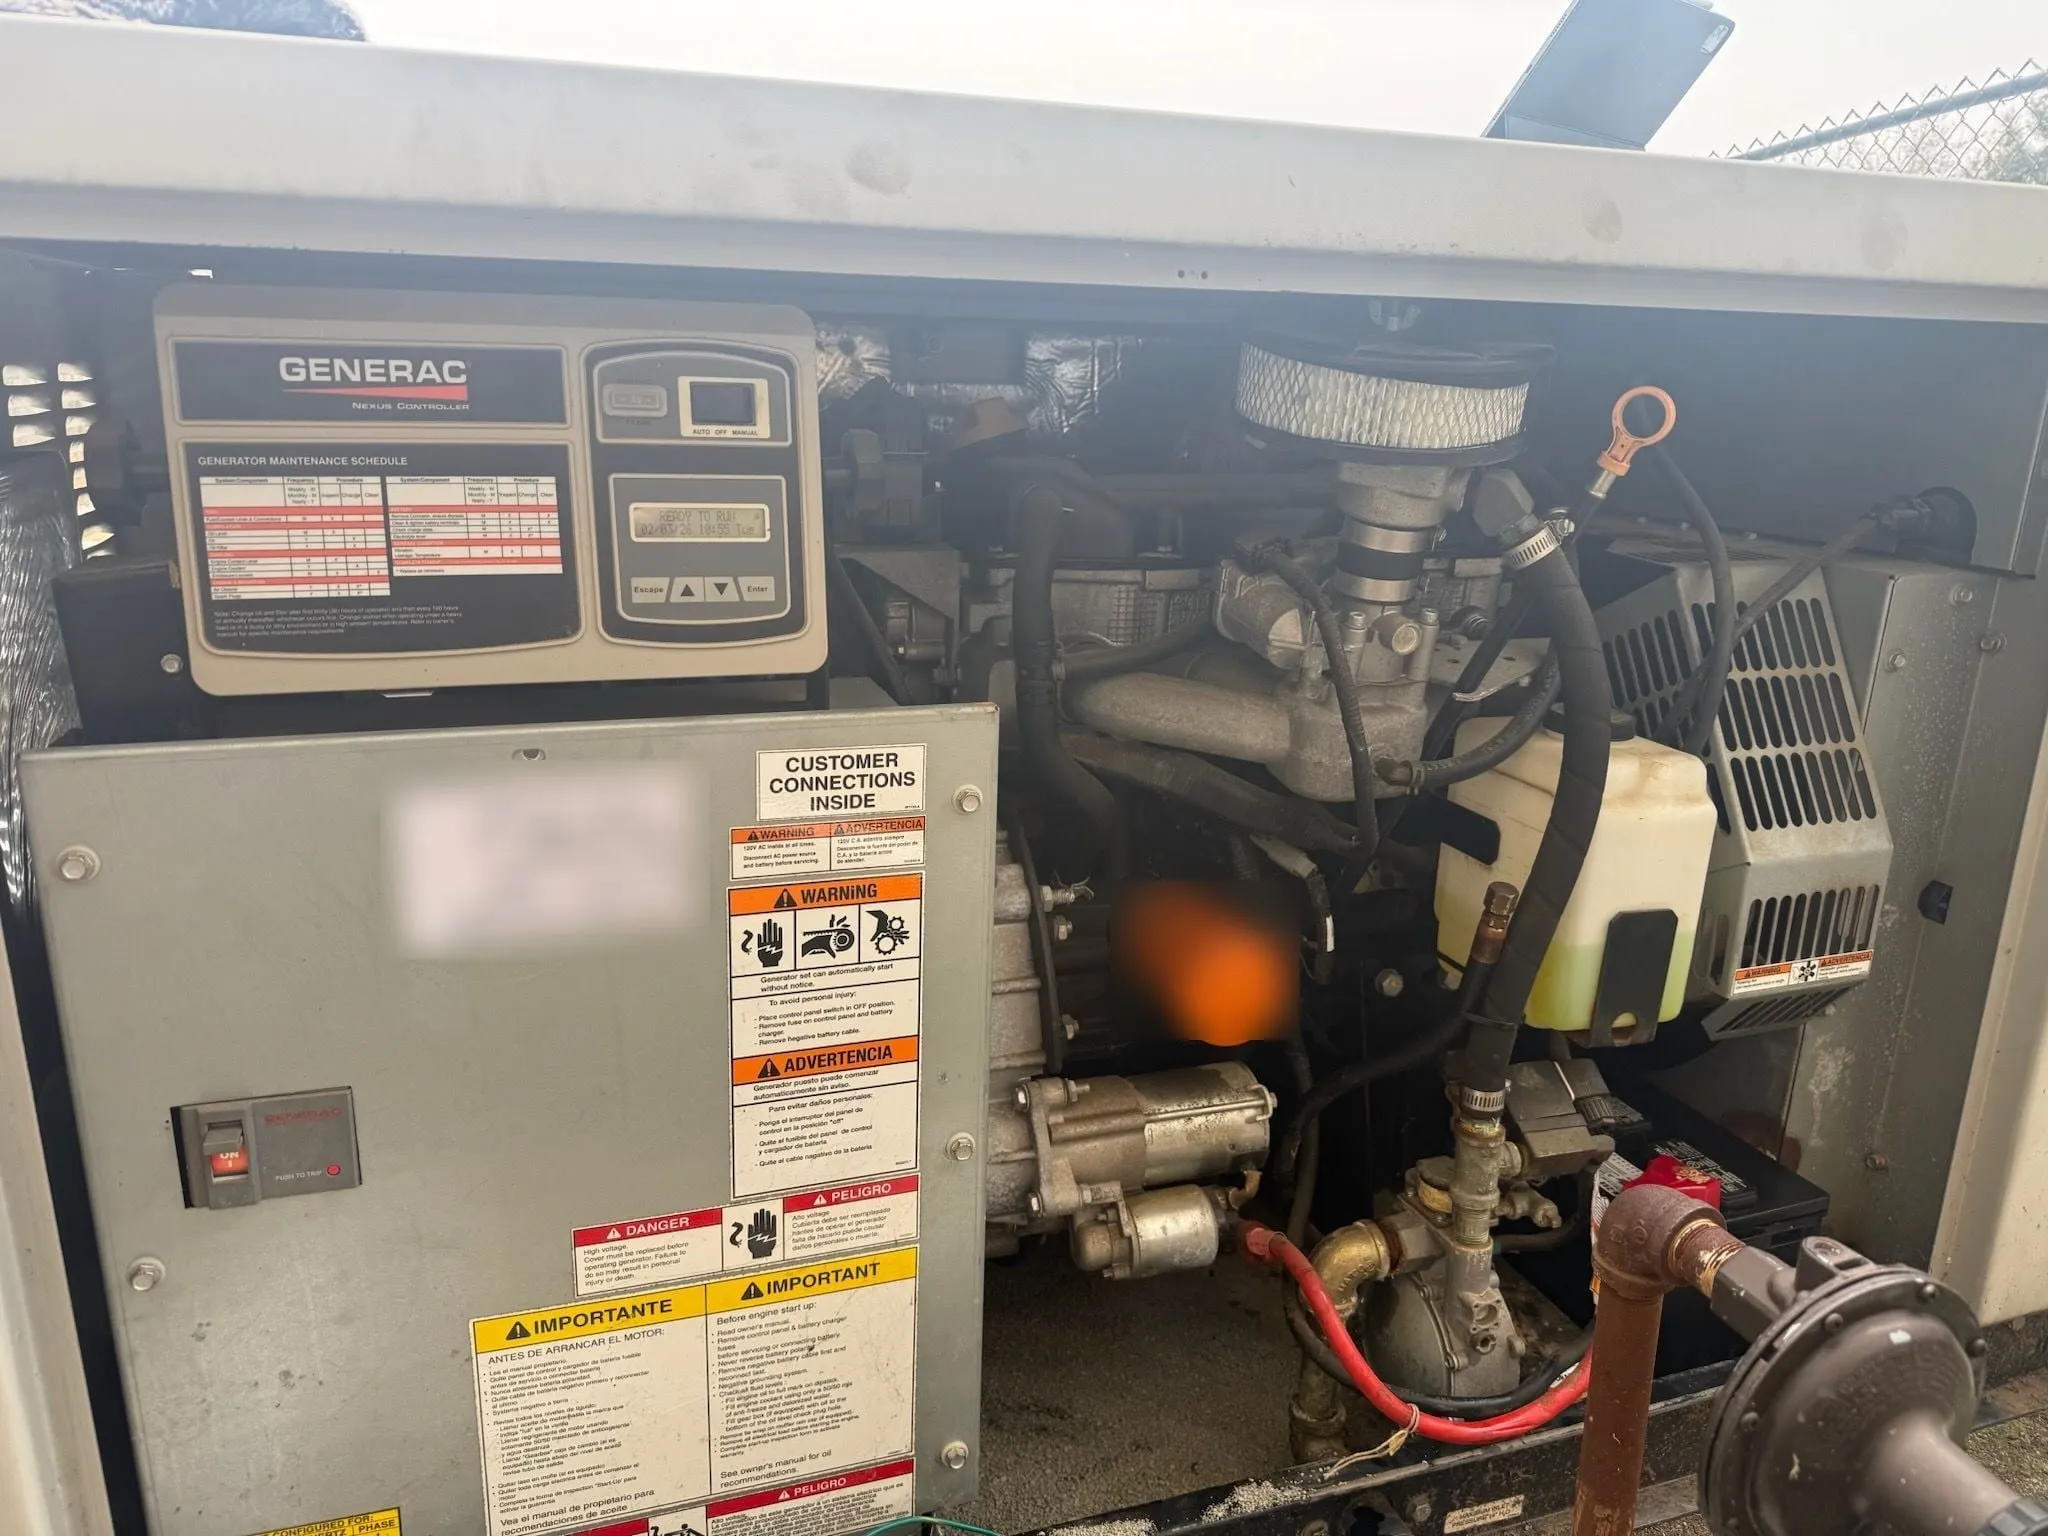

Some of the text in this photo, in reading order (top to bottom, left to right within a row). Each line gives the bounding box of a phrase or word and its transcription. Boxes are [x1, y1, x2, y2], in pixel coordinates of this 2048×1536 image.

[280, 357, 466, 384] GENERAC
[198, 456, 408, 466] GENERATOR MAINTENANCE SCHEDULE
[659, 510, 736, 522] READY TO RUN
[736, 525, 755, 534] Tue
[634, 586, 663, 594] Escape
[786, 752, 898, 772] CUSTOMER
[770, 771, 916, 793] CONNECTIONS
[810, 794, 876, 811] INSIDE
[759, 826, 814, 840] WARNING
[846, 818, 923, 833] ADVERTENCIA
[760, 974, 798, 984] Generator
[799, 971, 811, 979] set
[827, 964, 876, 976] automatically
[876, 962, 893, 971] start
[760, 981, 814, 992] without notice.
[779, 996, 800, 1005] avoid
[801, 992, 833, 1004] personal
[834, 991, 856, 999] injury:
[758, 1014, 777, 1022] Place
[778, 1010, 802, 1019] control
[803, 1008, 822, 1017] panel
[823, 1006, 845, 1014] switch
[852, 1002, 866, 1010] OFF
[867, 1000, 895, 1009] position.
[758, 1021, 786, 1029] Remove
[813, 1014, 836, 1023] control
[837, 1012, 856, 1021] panel
[856, 1010, 869, 1018] and
[870, 1008, 893, 1016] battery
[758, 1037, 786, 1045] Remove
[787, 1033, 816, 1042] negative
[841, 1027, 860, 1035] cable.
[784, 1044, 893, 1073] ADVERTENCIA
[275, 1174, 294, 1182] PUSH
[307, 1170, 322, 1178] TRIP
[831, 1182, 891, 1202] PELIGRO
[626, 1216, 689, 1236] DANGER
[583, 1255, 605, 1263] Cover
[605, 1252, 623, 1260] must
[635, 1244, 666, 1255] replaced
[666, 1241, 689, 1250] before
[584, 1260, 617, 1271] operating
[618, 1255, 653, 1267] generator.
[654, 1251, 678, 1259] Failure
[621, 1264, 641, 1272] result
[650, 1257, 680, 1269] personal
[584, 1278, 604, 1287] injury
[767, 1262, 880, 1295] IMPORTANT
[534, 1298, 672, 1334] IMPORTANTE
[716, 1302, 816, 1325] Before engine start up:
[488, 1327, 664, 1365] ANTES DE ARRANCAR EL MOTOR:
[720, 1470, 738, 1479] See
[774, 1454, 806, 1467] manual
[821, 1448, 832, 1457] oil
[720, 1467, 798, 1488] recommendations.
[794, 1477, 847, 1496] PELIGRO
[500, 1489, 655, 1526] Vea el manual de propietario para
[348, 1515, 373, 1527] FOR:
[358, 1520, 395, 1532] PHASE
[501, 1504, 627, 1536] recomendaciones de aceite
